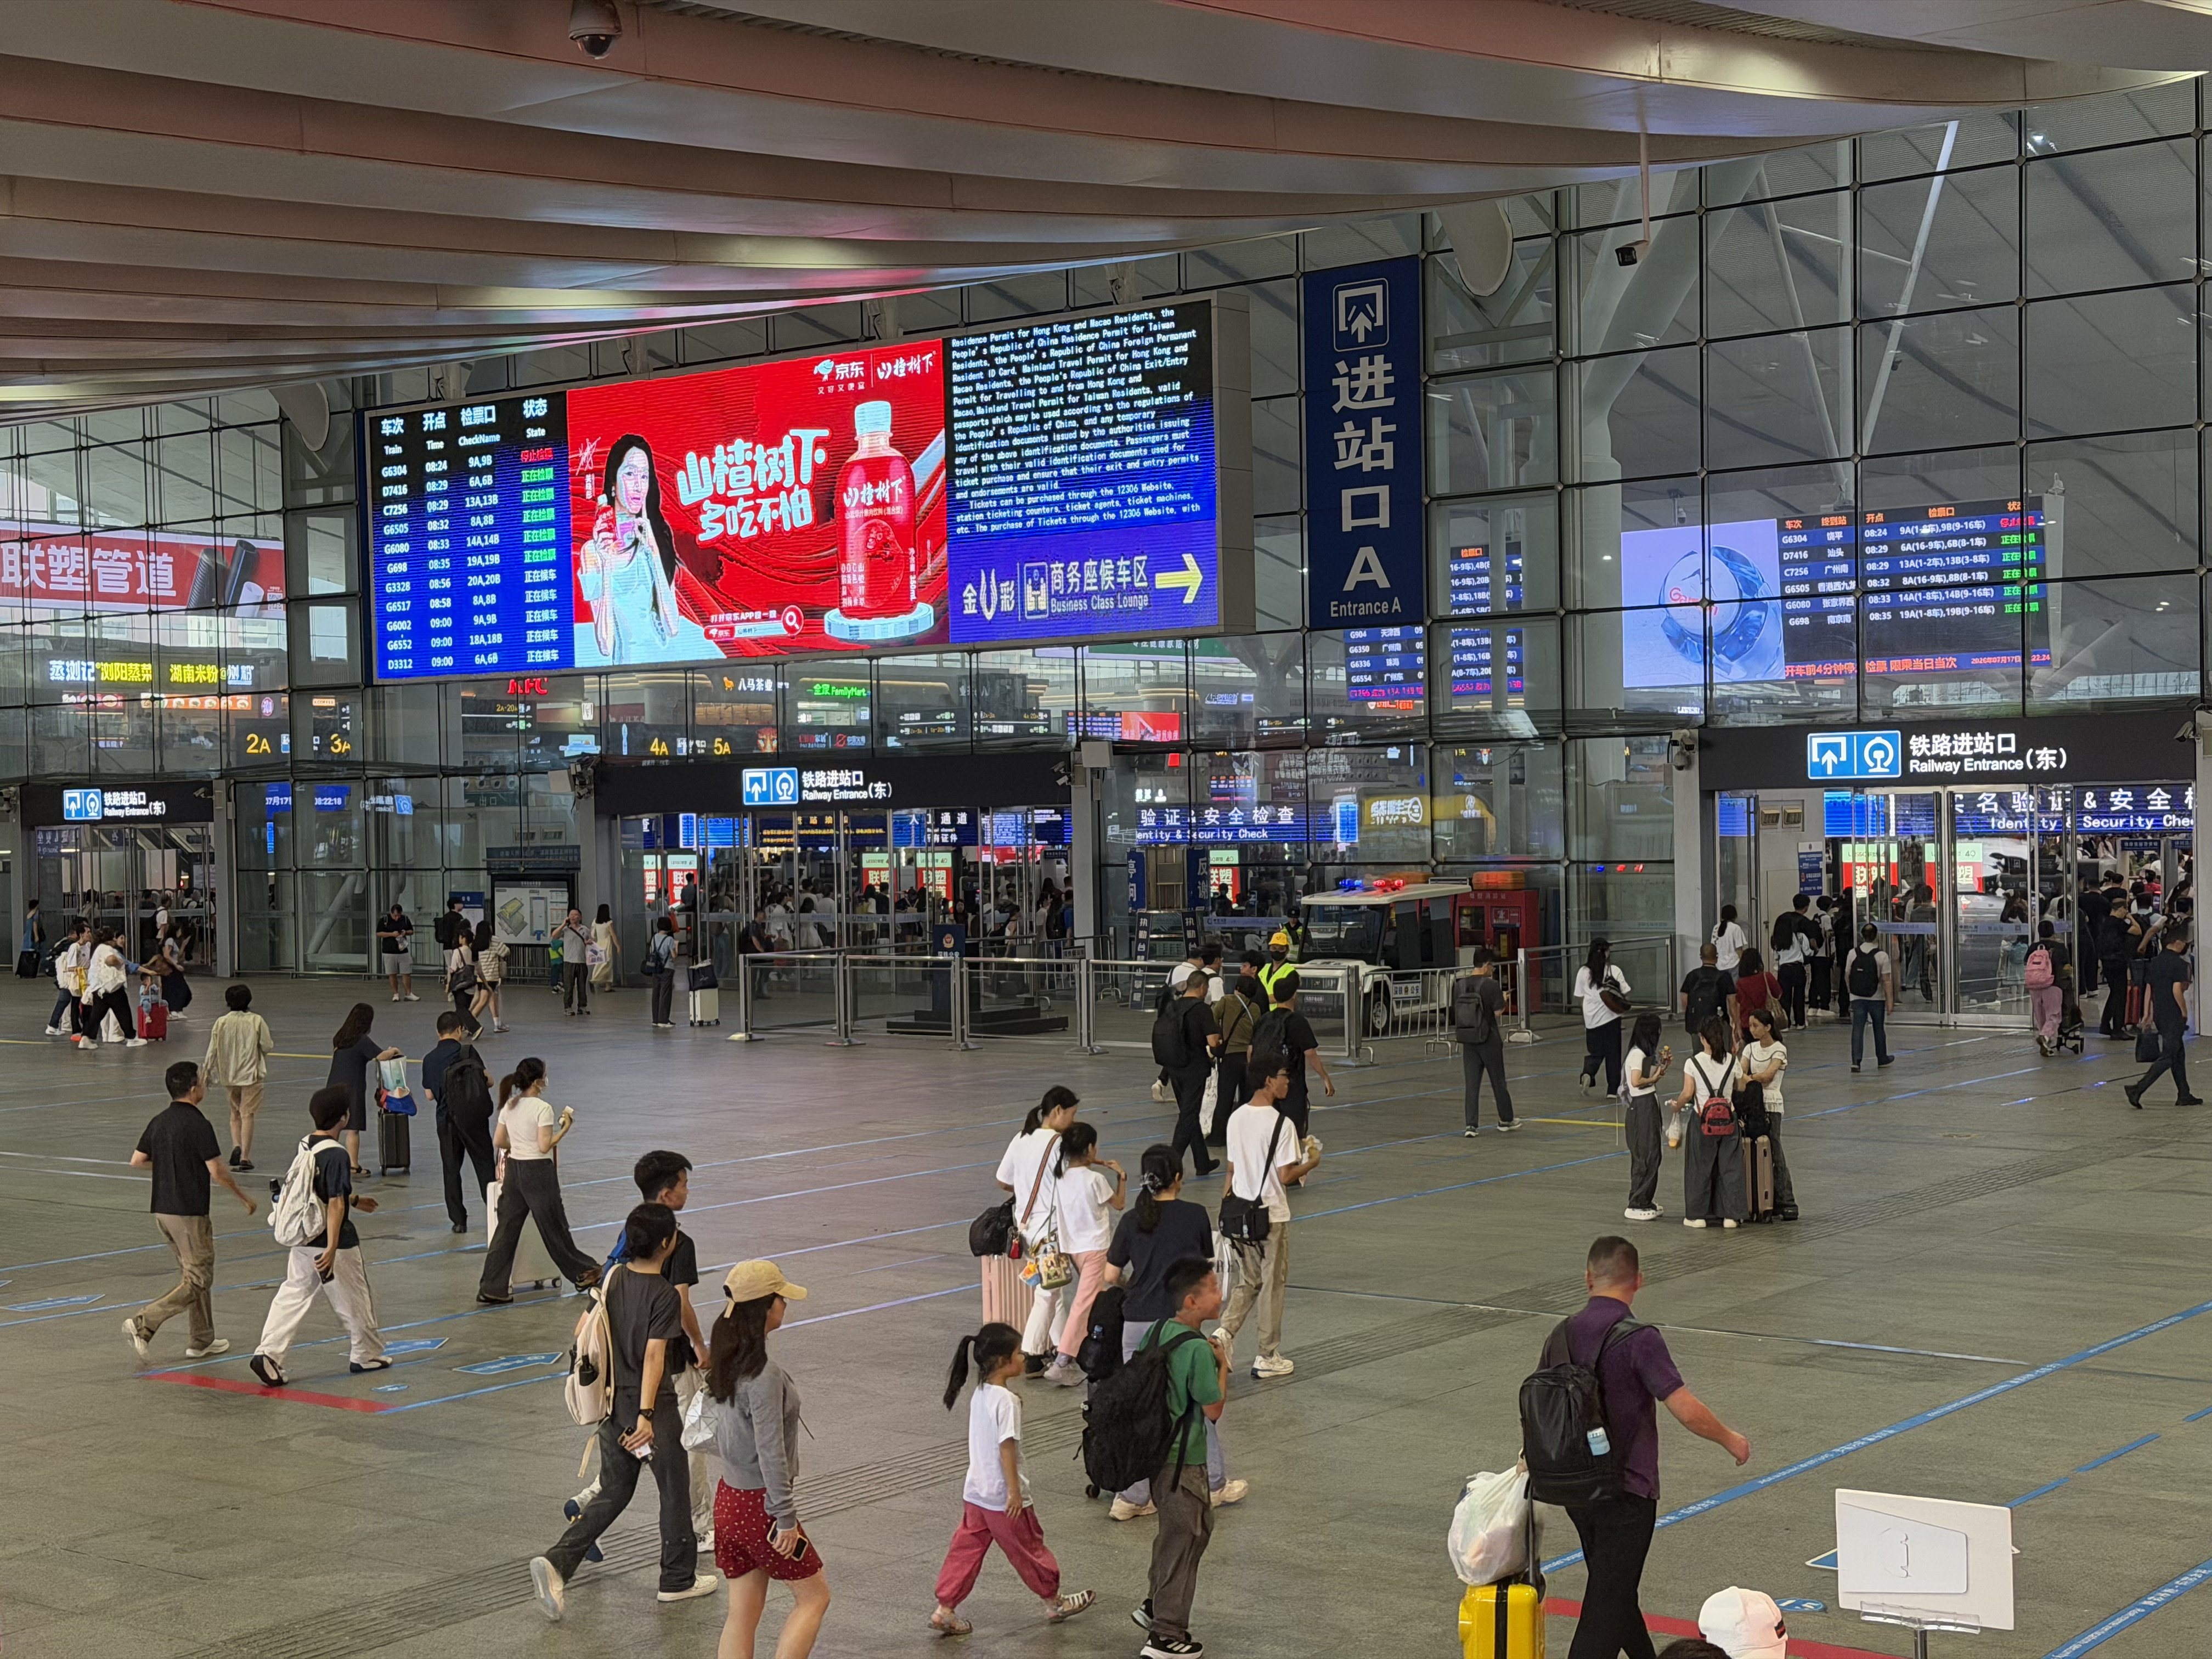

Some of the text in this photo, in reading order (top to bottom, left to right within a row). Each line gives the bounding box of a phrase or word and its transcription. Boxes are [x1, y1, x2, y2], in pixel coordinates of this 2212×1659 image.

[835, 353, 933, 380] 京东 山楂树下
[952, 371, 983, 382] Resident
[1058, 357, 1082, 368] Travel
[1086, 354, 1111, 365] Permit
[1115, 351, 1128, 360] for
[1132, 349, 1149, 358] Hong
[1153, 346, 1171, 356] Kong
[1174, 342, 1188, 353] and
[953, 394, 977, 405] Permit
[979, 393, 992, 402] for
[995, 388, 1035, 400] Travelling
[1051, 383, 1063, 393] and
[1087, 380, 1104, 388] Hong
[1107, 377, 1125, 386] Kong
[1128, 373, 1142, 383] and
[381, 398, 547, 436] 车次 开点 检票口 状态
[384, 444, 402, 455] Train
[426, 440, 444, 450] Time
[527, 428, 545, 438] State
[382, 455, 492, 477] G6304 08:24 9A,9B
[678, 429, 830, 507] 山楂树下
[383, 475, 493, 496] D7416 08:29 6A,6B
[843, 479, 902, 507] 山楂树下
[383, 494, 498, 516] C7256 08:29 13A,13B
[698, 484, 813, 542] 多吃不怕
[384, 515, 494, 535] G6505 08:32 8A,8B
[991, 521, 1022, 532] purchase
[1026, 518, 1034, 527] of
[1038, 517, 1066, 526] Tickets
[1070, 513, 1099, 523] through
[1119, 508, 1141, 518] 12306
[1182, 503, 1200, 512] with
[1786, 520, 1802, 529] 车次
[1866, 513, 1883, 523] 开点
[385, 534, 499, 554] G6080 08:33 14A,14B
[1782, 535, 1807, 543] G6304
[1865, 528, 1887, 537] 08:24
[1784, 551, 1808, 560] D7416
[1865, 545, 1888, 554] 08:29
[1, 543, 177, 596] 联塑管道
[387, 554, 500, 573] G698 08:35 19A,19B
[1784, 567, 1808, 576] C7256
[1825, 564, 1848, 574] 广州南
[1866, 562, 1889, 571] 08:29
[386, 569, 556, 592] G3328 08:56 20A,20B 正在候车
[1051, 555, 1148, 594] 商务座候车区
[1785, 584, 1809, 593] G6505
[1867, 578, 1889, 587] 08:32
[386, 589, 557, 612] G6517 08:58 8A,8B 正在候车
[1051, 593, 1148, 613] Business Class Lounge
[1331, 599, 1401, 617] Entrance A
[1786, 601, 1810, 609] G6080
[1869, 595, 1891, 603] 08:33
[387, 609, 557, 631] G6002 09:00 9A,9B 正在候车
[1789, 617, 1809, 625] G698
[1870, 612, 1892, 620] 08:35
[387, 629, 558, 650] G6552 09:00 18A,18B 正在候车
[1349, 645, 1369, 653] G6350
[388, 649, 559, 669] D3312 09:00 6A,6B 正在候车
[1350, 660, 1370, 668] G6336
[1890, 657, 1957, 672] 限乘当日当次
[49, 661, 95, 681] 蒸浏记
[101, 662, 153, 681] 浏阳蒸菜
[738, 678, 773, 692] 八马茶业
[832, 686, 866, 699] FamilyMart
[247, 733, 271, 754] 2A
[330, 733, 351, 753] 3A
[650, 737, 668, 756] 4A
[714, 737, 730, 755] 5A
[1910, 732, 2015, 757] 铁路进站口
[1910, 747, 2066, 774] Railway Entrance (东)
[802, 770, 863, 788] 铁路进站口
[104, 791, 146, 806] 铁路进站口
[803, 781, 891, 802] Railway Entrance (东)
[104, 801, 165, 817] Railway Entrance (东)
[1991, 815, 2153, 830] Identty Security
[1239, 828, 1268, 838] Check
